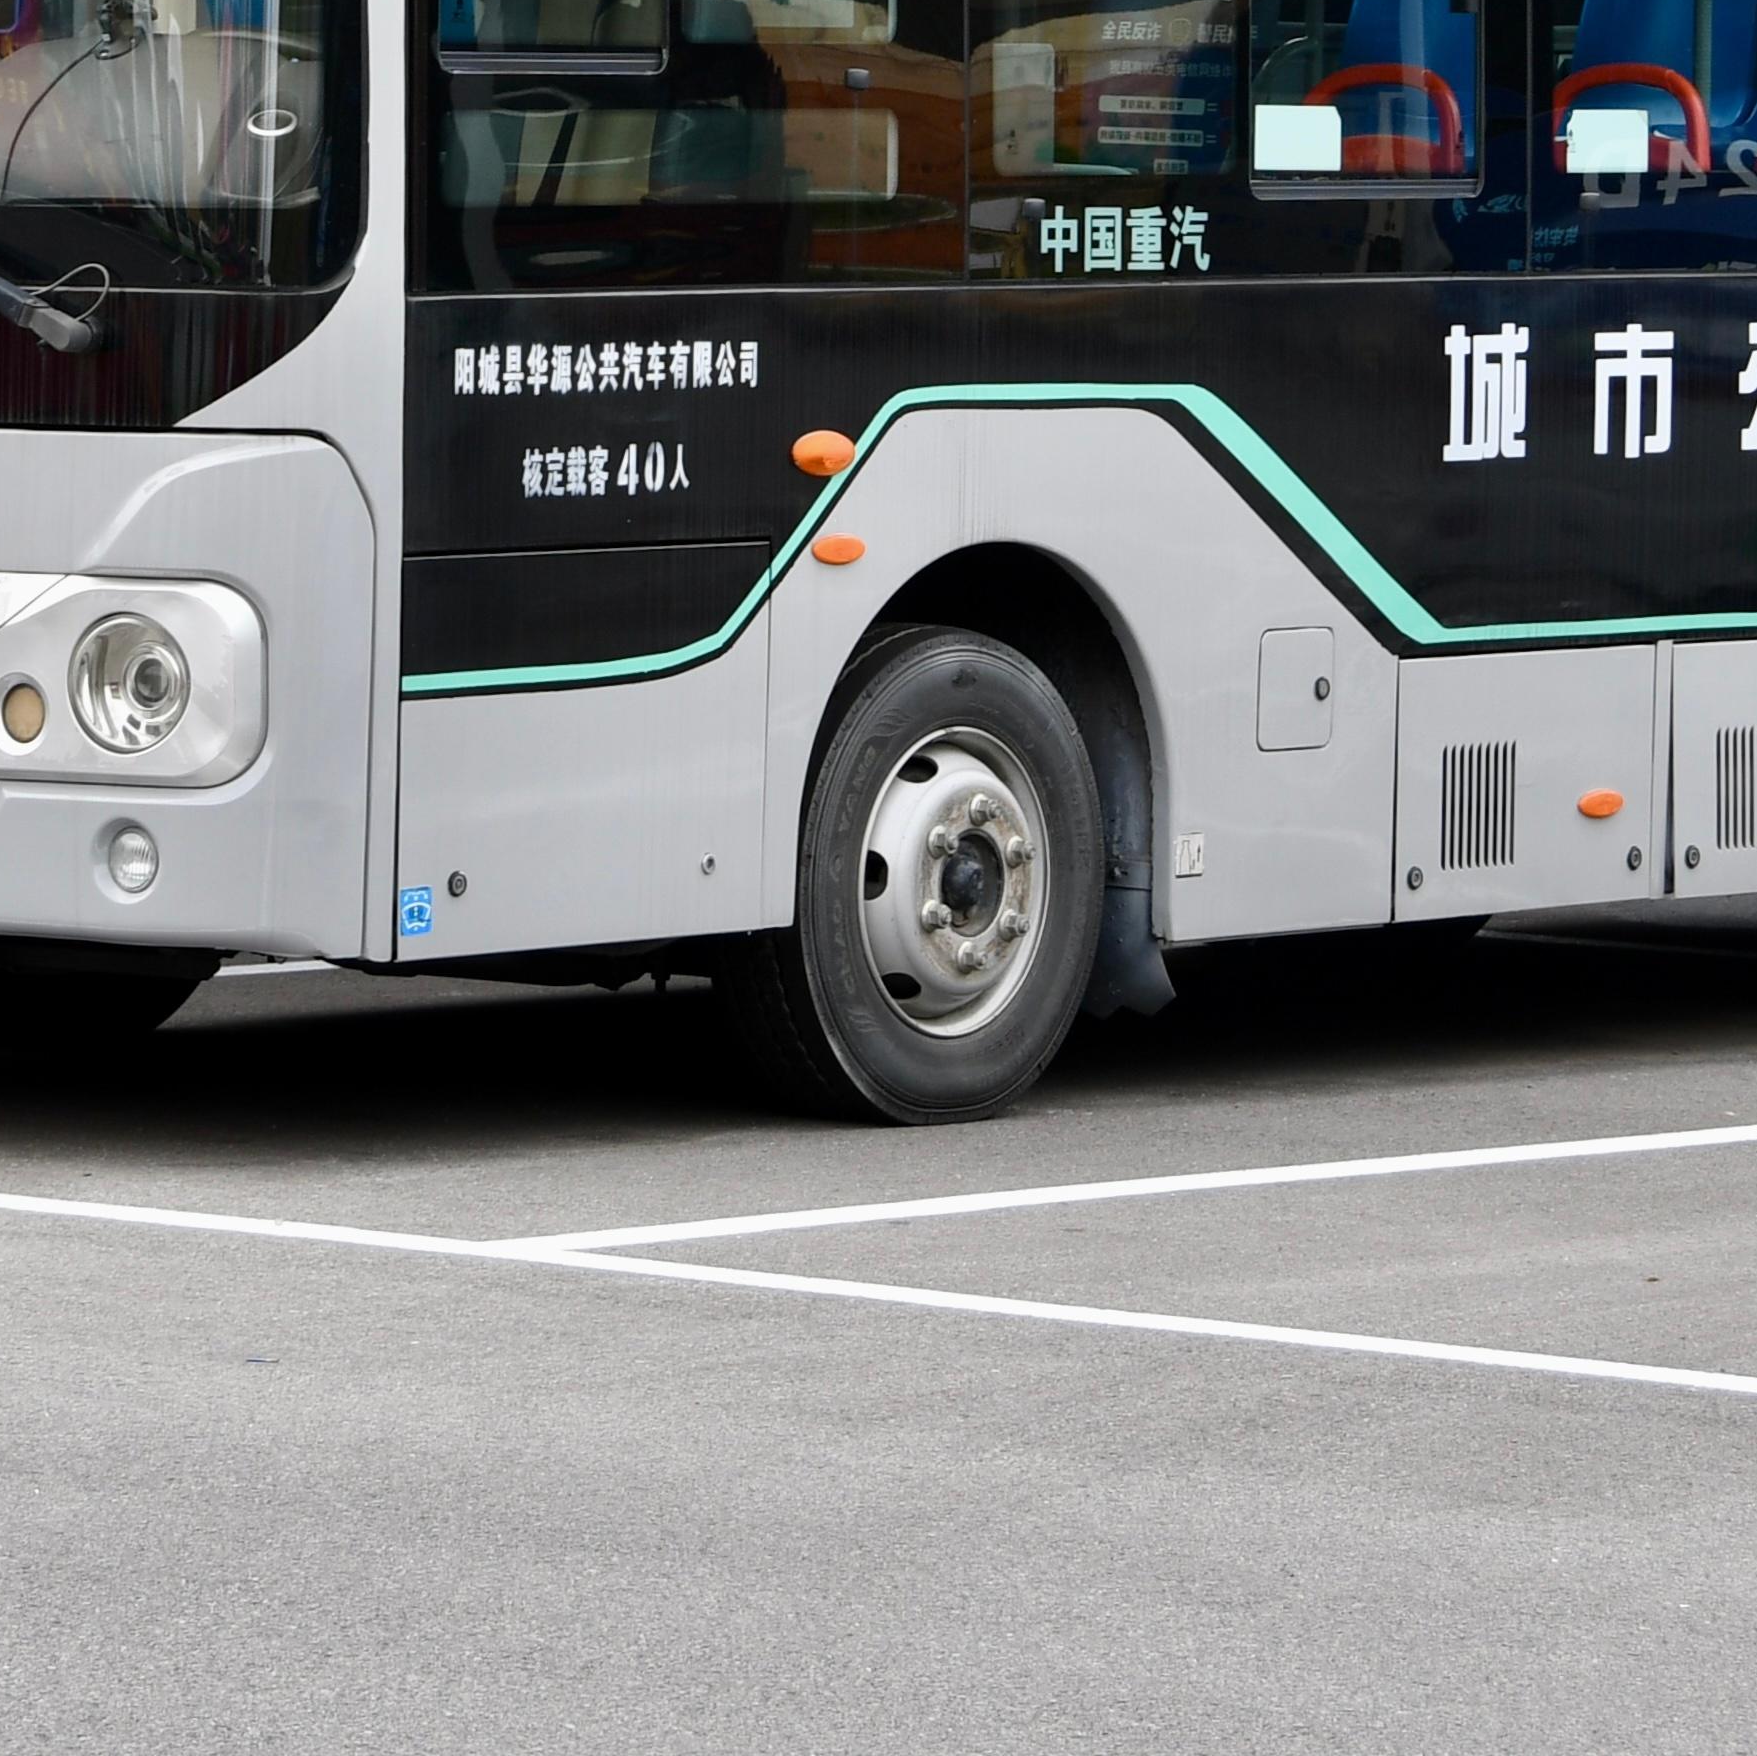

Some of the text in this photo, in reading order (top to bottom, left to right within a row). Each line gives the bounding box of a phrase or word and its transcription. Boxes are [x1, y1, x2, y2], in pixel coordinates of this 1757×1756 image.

[1101, 20, 1162, 41] 全民反诈
[1040, 205, 1211, 273] 中国重汽
[454, 340, 759, 396] 阳城县华源公共汽车有限公司
